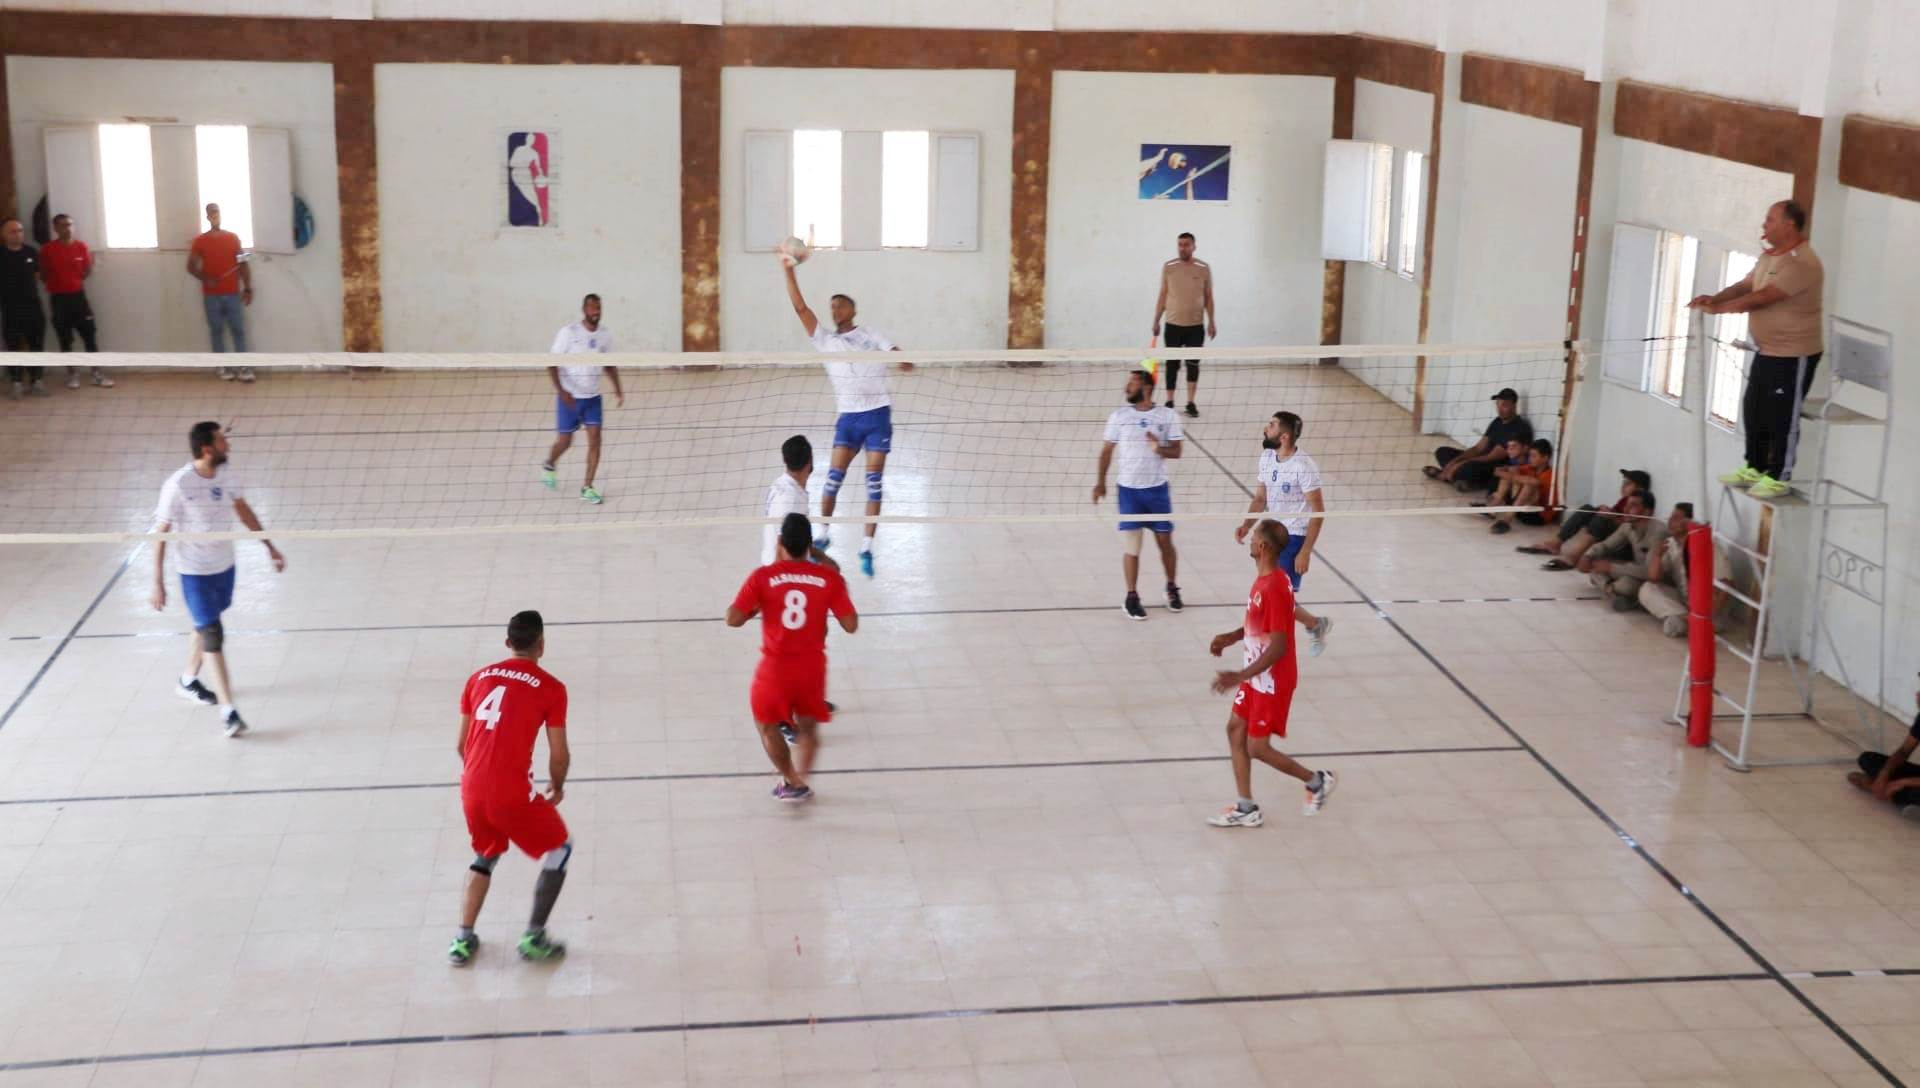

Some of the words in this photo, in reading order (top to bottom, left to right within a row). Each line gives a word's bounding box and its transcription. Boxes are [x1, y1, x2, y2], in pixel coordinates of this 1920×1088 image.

[1271, 470, 1278, 482] 8
[769, 573, 826, 588] ALSANADID
[1827, 550, 1873, 596] OPC
[781, 589, 807, 630] 8
[478, 668, 541, 688] ALSANADID
[475, 685, 507, 730] 4
